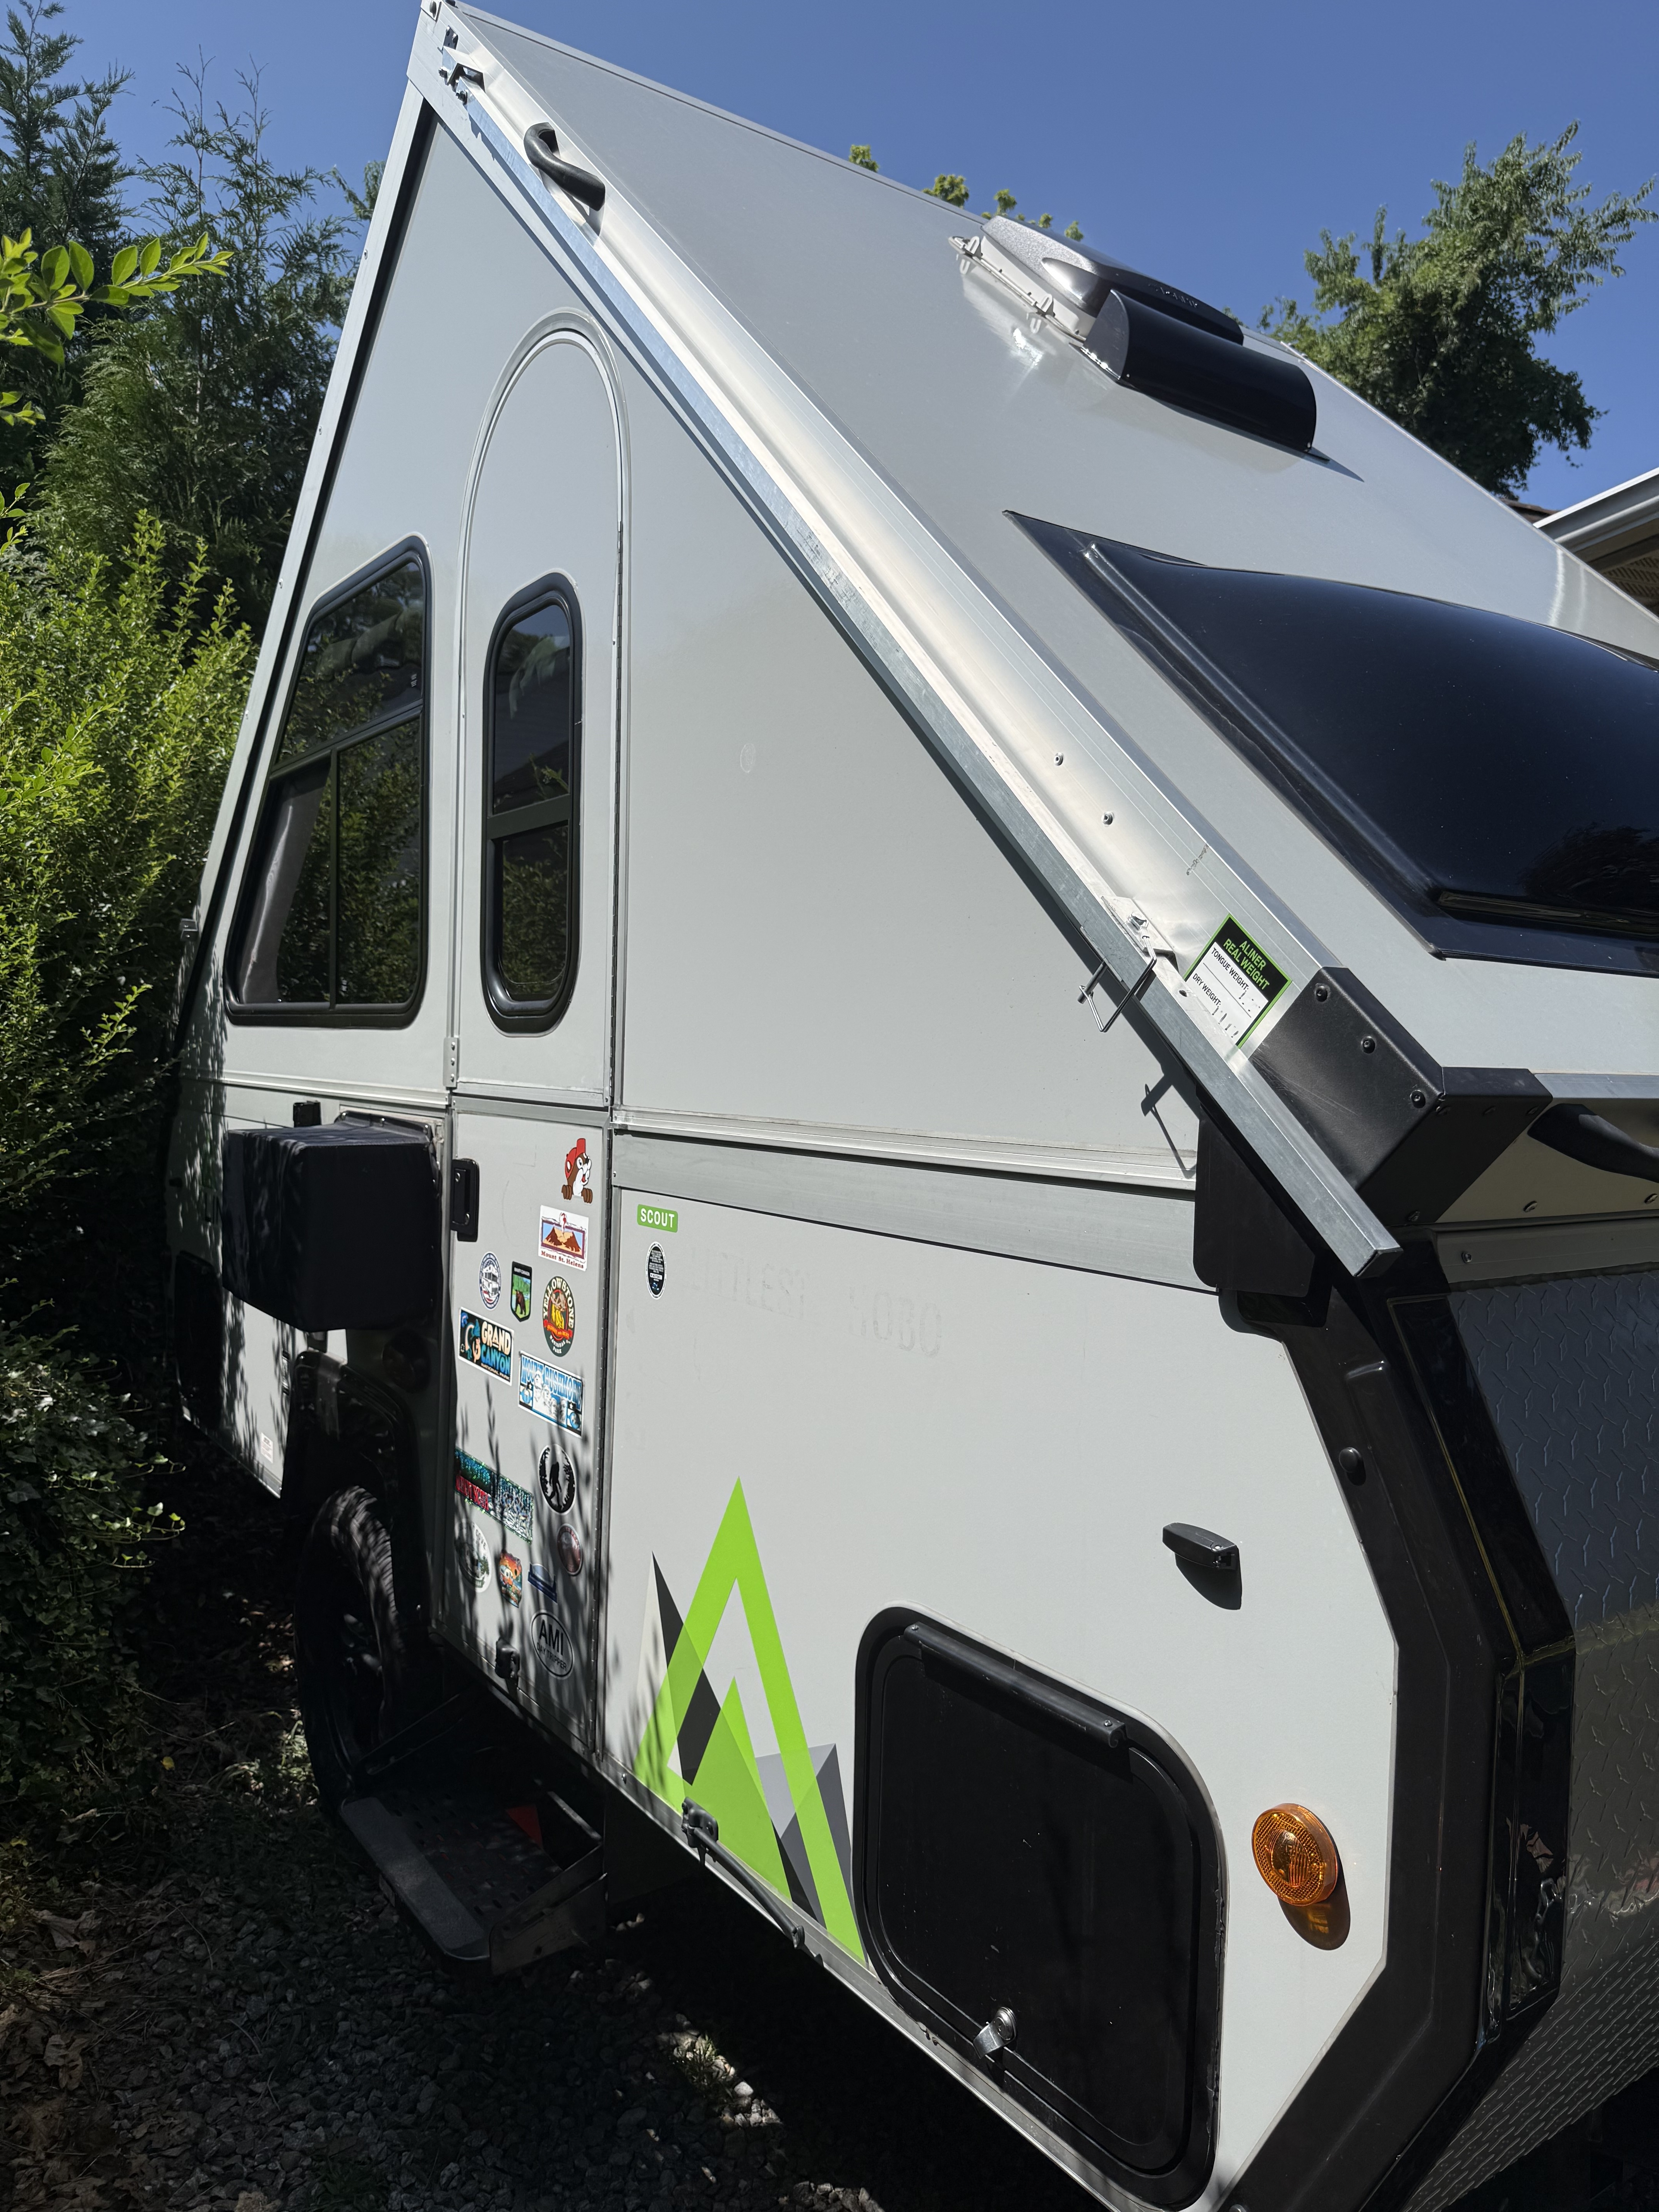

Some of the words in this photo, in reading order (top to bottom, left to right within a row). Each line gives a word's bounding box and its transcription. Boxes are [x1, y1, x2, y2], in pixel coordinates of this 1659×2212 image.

[1211, 948, 1231, 971] TONGUE
[1229, 967, 1249, 992] WEIGHT:
[1223, 938, 1242, 962] REAL
[1240, 957, 1270, 990] WEIGHT
[1239, 941, 1266, 970] ALINER
[1193, 973, 1204, 986] DRY
[1202, 983, 1221, 1008] WEIGHT:
[641, 1208, 675, 1228] SCOUT
[567, 1259, 584, 1269] Helens
[543, 1277, 574, 1329] YELLOWSTONE
[481, 1321, 511, 1355] GRAND
[481, 1344, 510, 1375] CANYON
[544, 1365, 581, 1410] RUSHMORE
[539, 1620, 563, 1656] AMI
